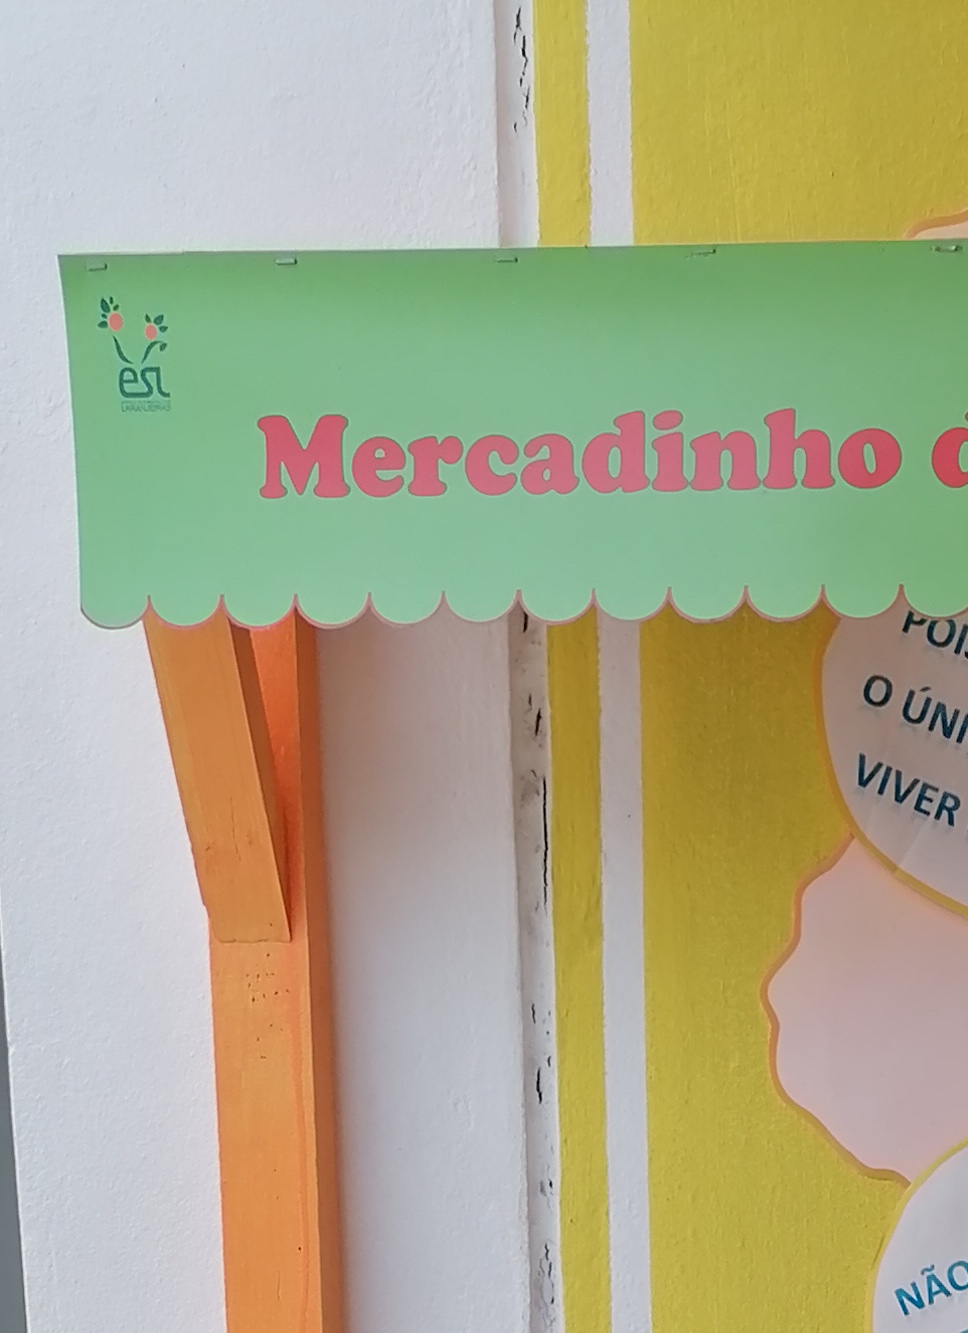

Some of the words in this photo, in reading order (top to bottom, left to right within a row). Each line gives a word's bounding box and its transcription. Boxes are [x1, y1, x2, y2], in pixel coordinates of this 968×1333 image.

[257, 408, 903, 499] Mercadinho
[863, 676, 893, 707] O
[855, 754, 960, 828] VIVER
